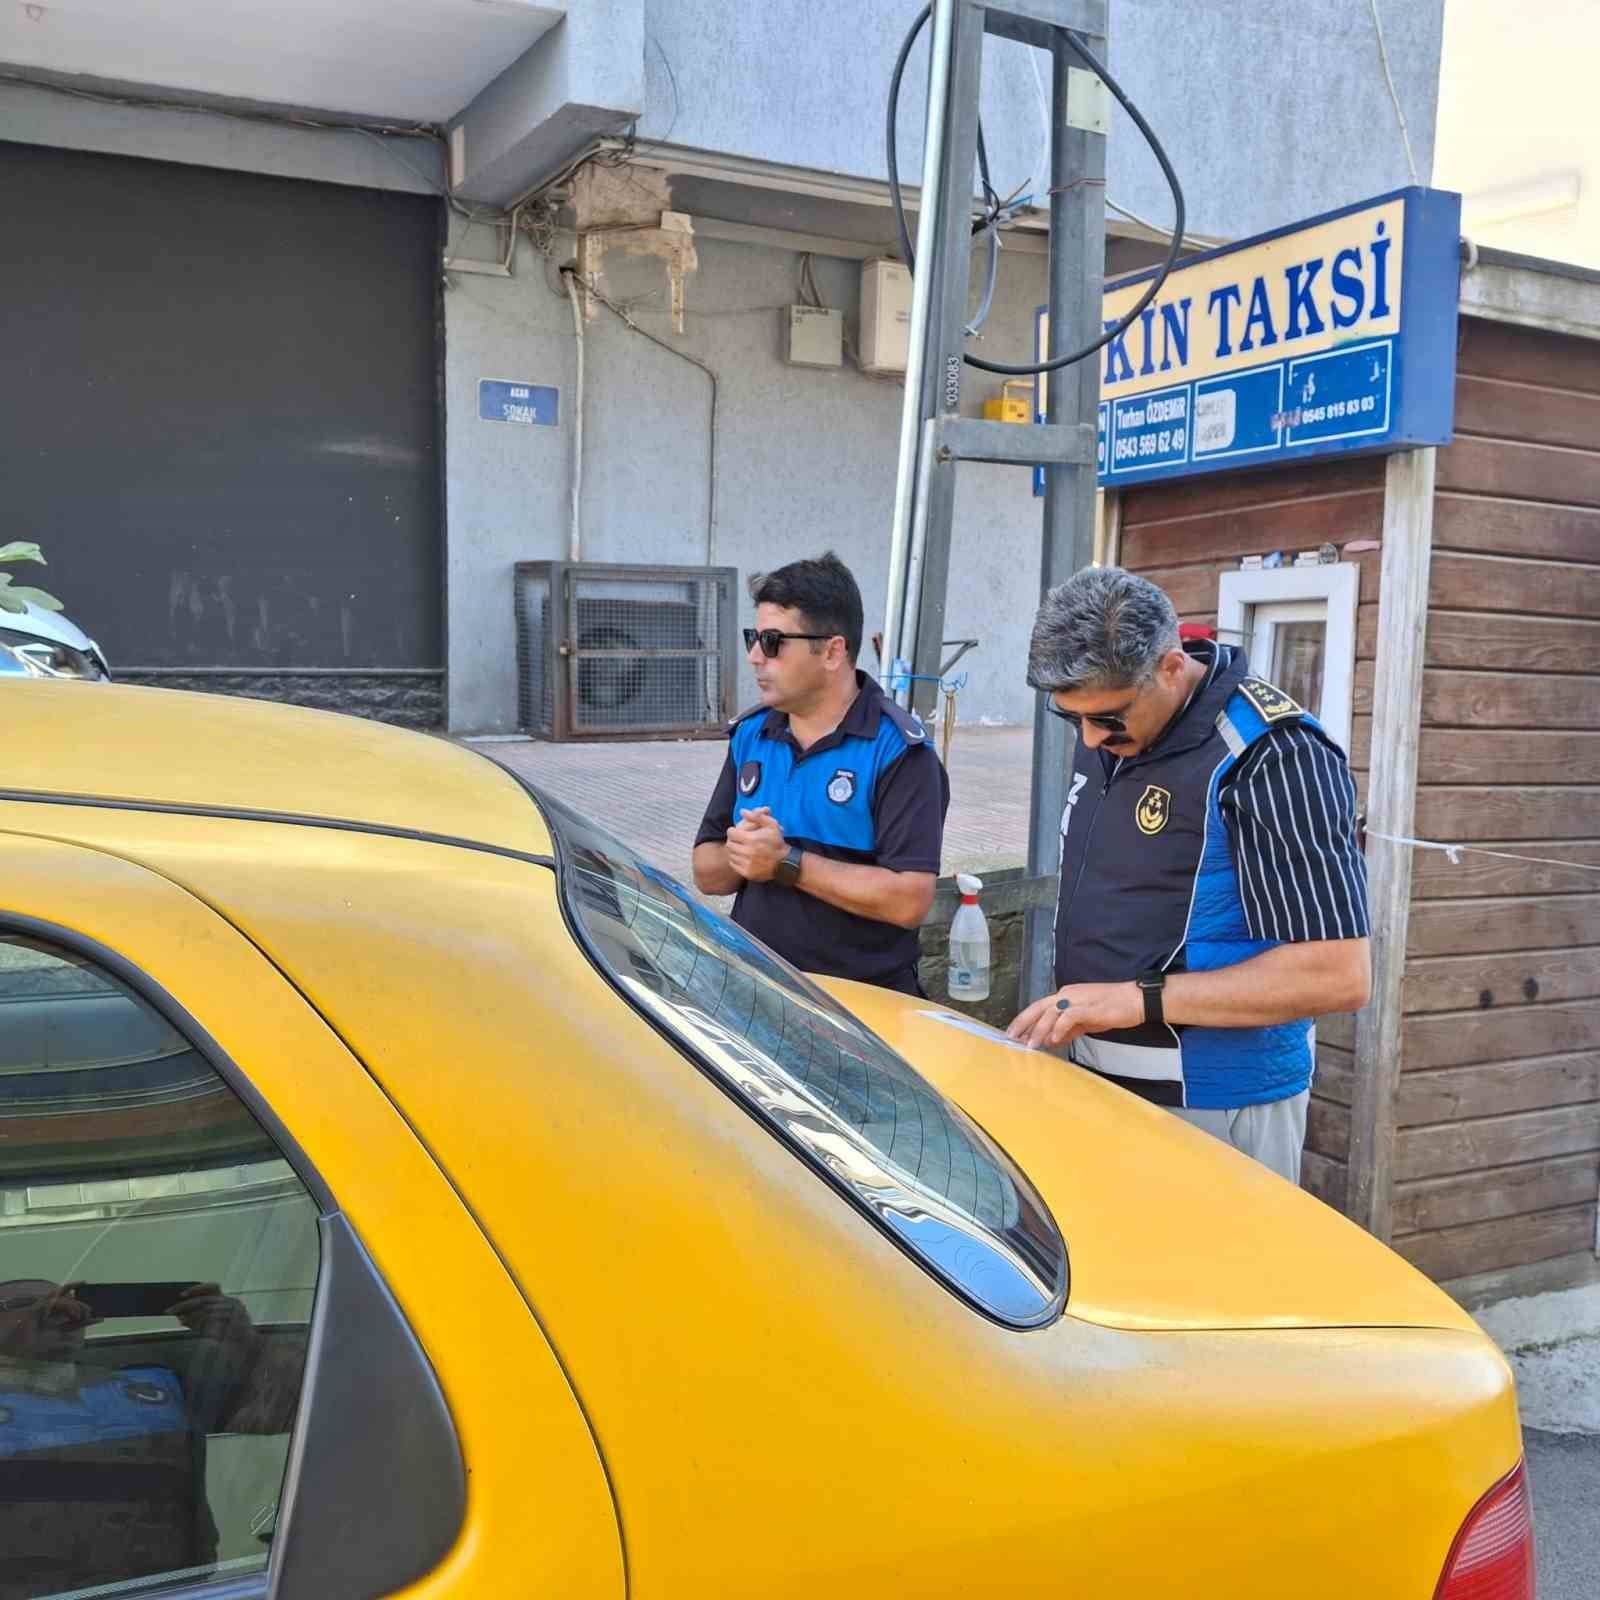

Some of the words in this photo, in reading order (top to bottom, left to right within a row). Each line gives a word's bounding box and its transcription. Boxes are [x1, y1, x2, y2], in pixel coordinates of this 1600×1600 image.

[1208, 221, 1391, 358] TAKSİ
[1115, 436, 1138, 461] 0543
[1158, 430, 1171, 453] 62
[1171, 427, 1185, 451] 49
